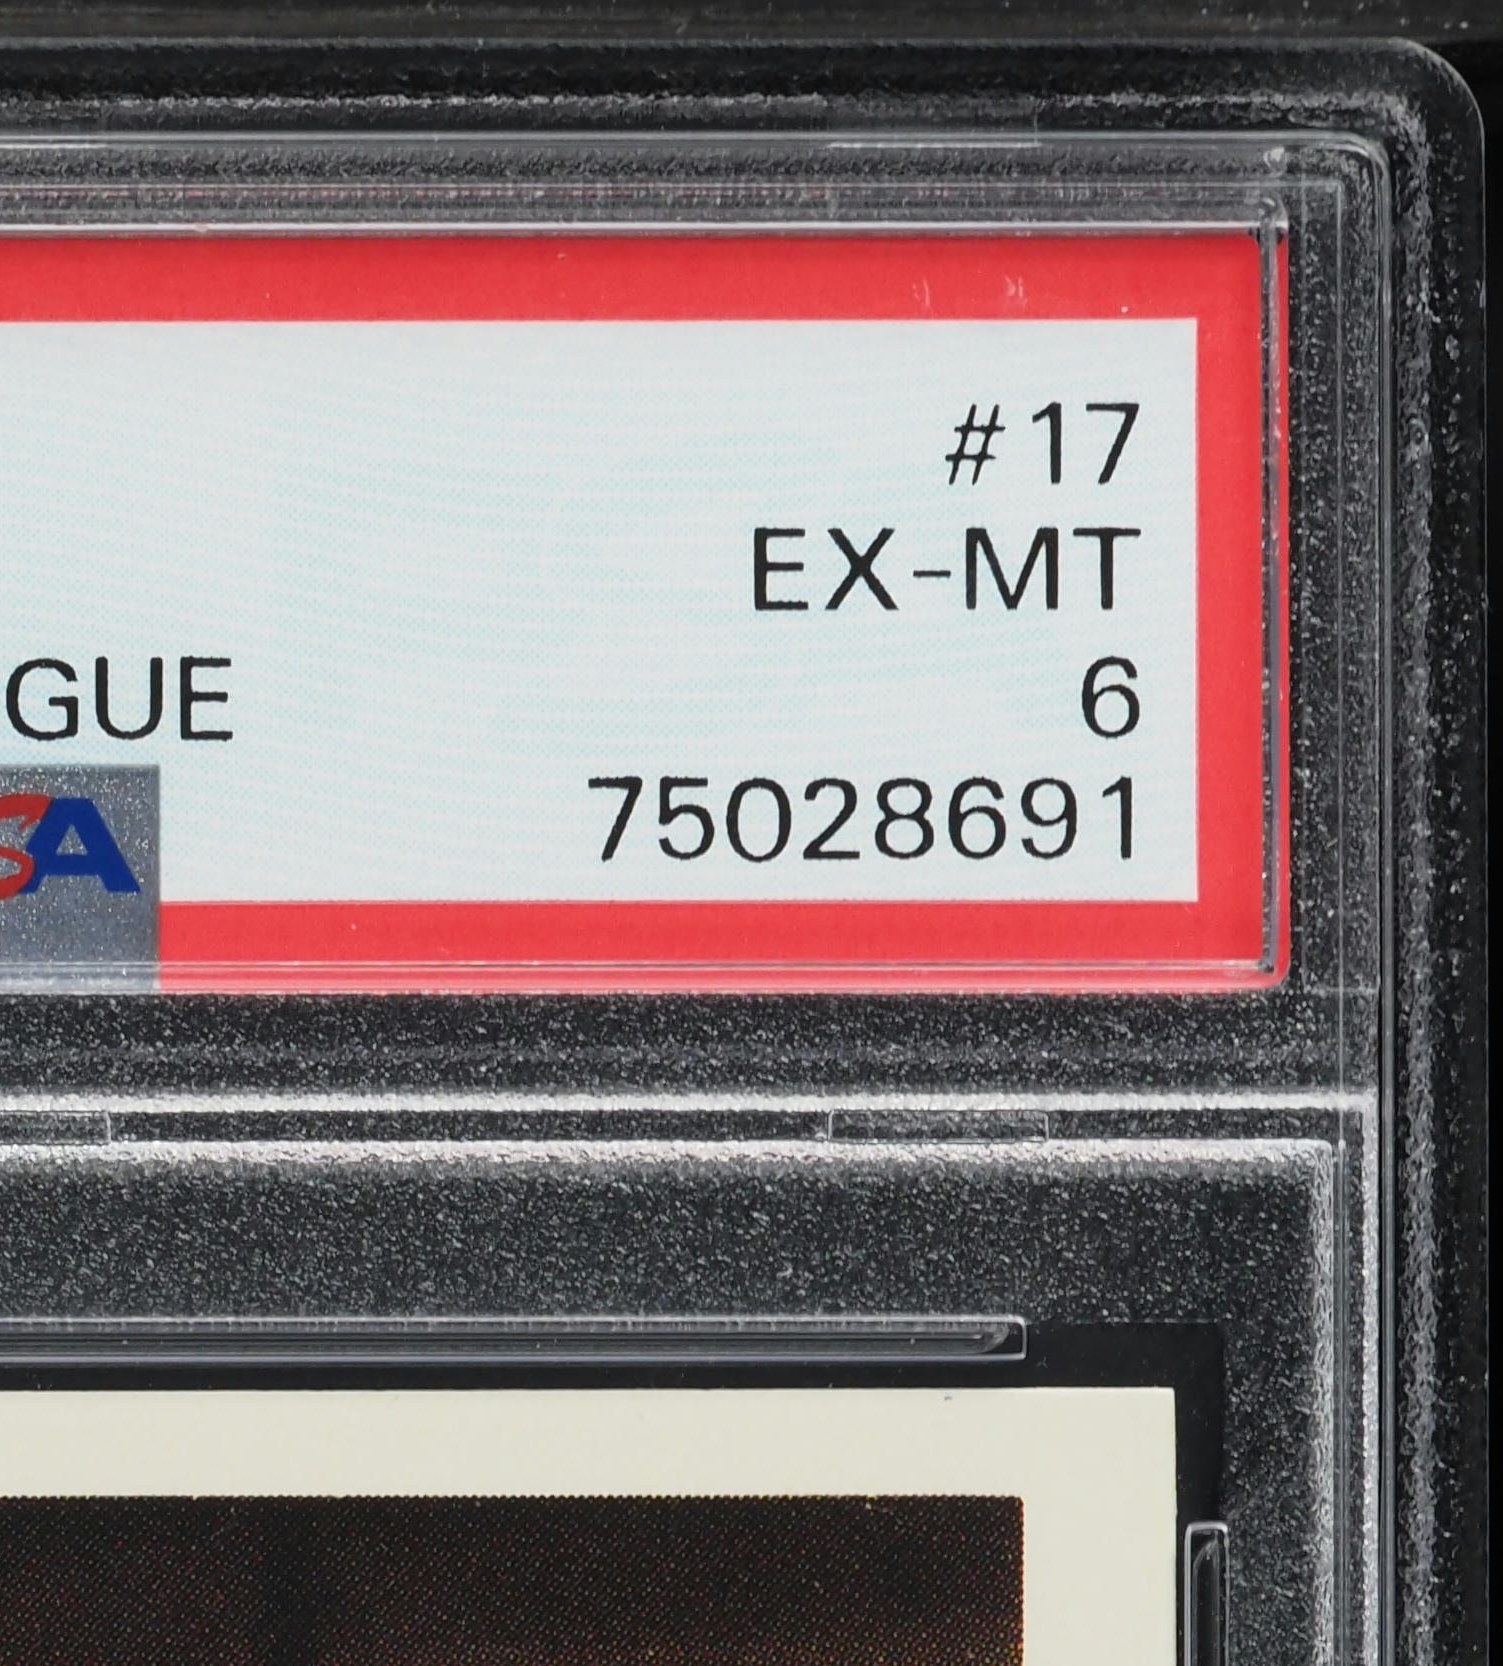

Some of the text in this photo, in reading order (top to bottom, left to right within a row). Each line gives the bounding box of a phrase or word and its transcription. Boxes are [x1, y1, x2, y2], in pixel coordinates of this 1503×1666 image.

[945, 401, 1140, 486] #17
[753, 526, 1142, 612] EX-MT
[1081, 655, 1140, 739] 6
[588, 775, 1133, 863] 75028691
